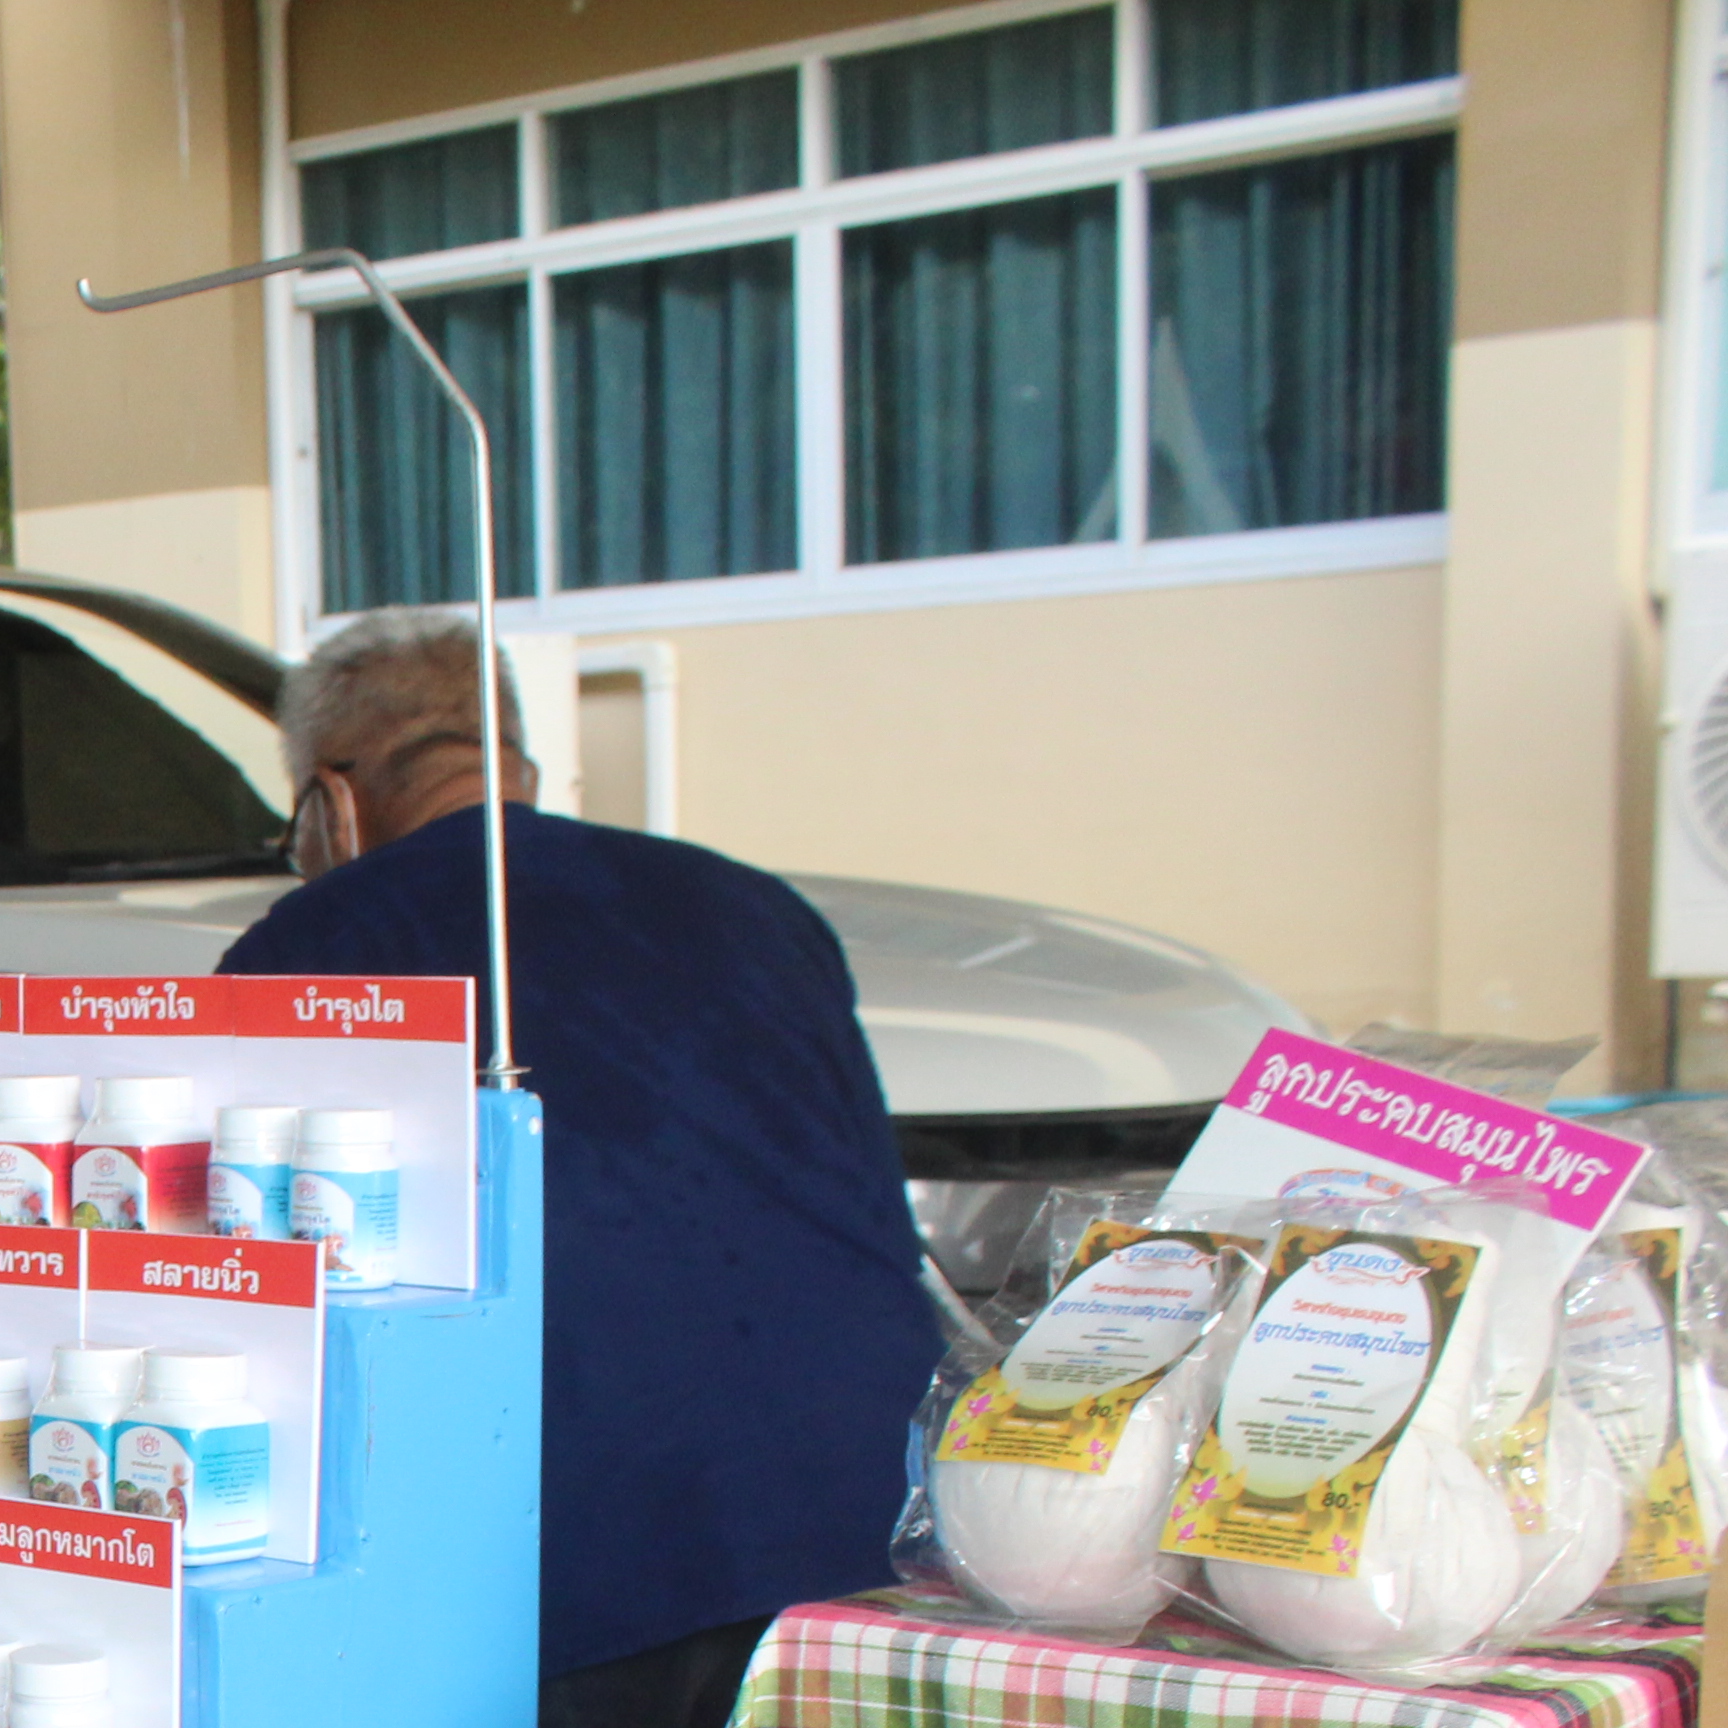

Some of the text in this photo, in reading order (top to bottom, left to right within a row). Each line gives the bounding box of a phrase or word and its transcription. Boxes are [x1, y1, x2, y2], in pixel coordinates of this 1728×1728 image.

[61, 982, 196, 1032] บำรุงหัวใจ
[293, 984, 405, 1034] บำรุงไต
[1245, 1052, 1612, 1197] ลูกประคบสมุนไพร
[143, 1248, 261, 1296] สลายนิ่ว
[1254, 1321, 1431, 1358] ลูกประคบสมุนไพร
